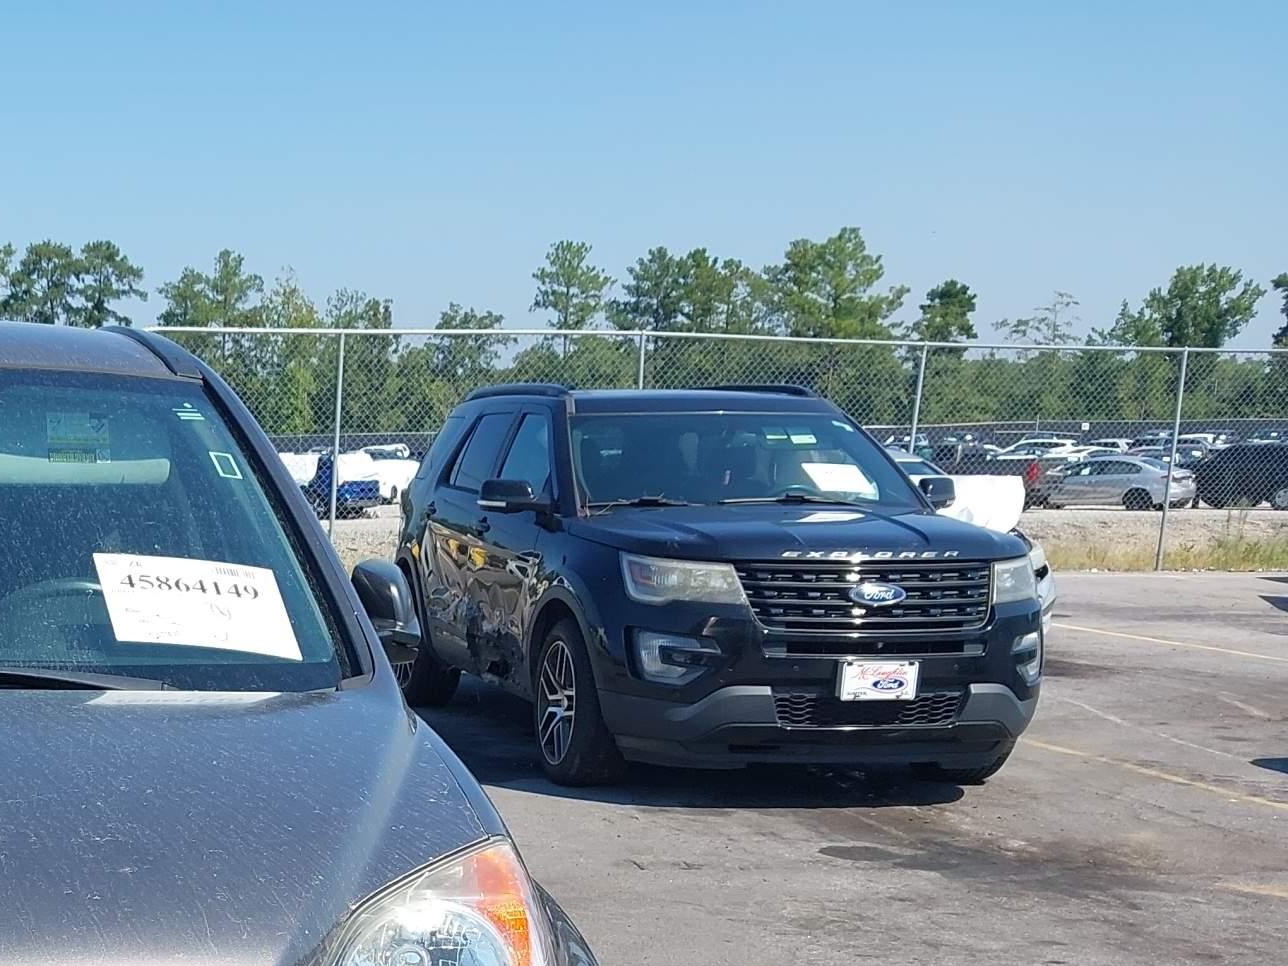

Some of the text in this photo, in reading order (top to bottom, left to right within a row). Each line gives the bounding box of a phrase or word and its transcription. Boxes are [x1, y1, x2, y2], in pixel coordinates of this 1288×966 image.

[781, 551, 960, 560] EXPLORER
[119, 573, 260, 600] 45864149
[863, 584, 895, 600] Ford
